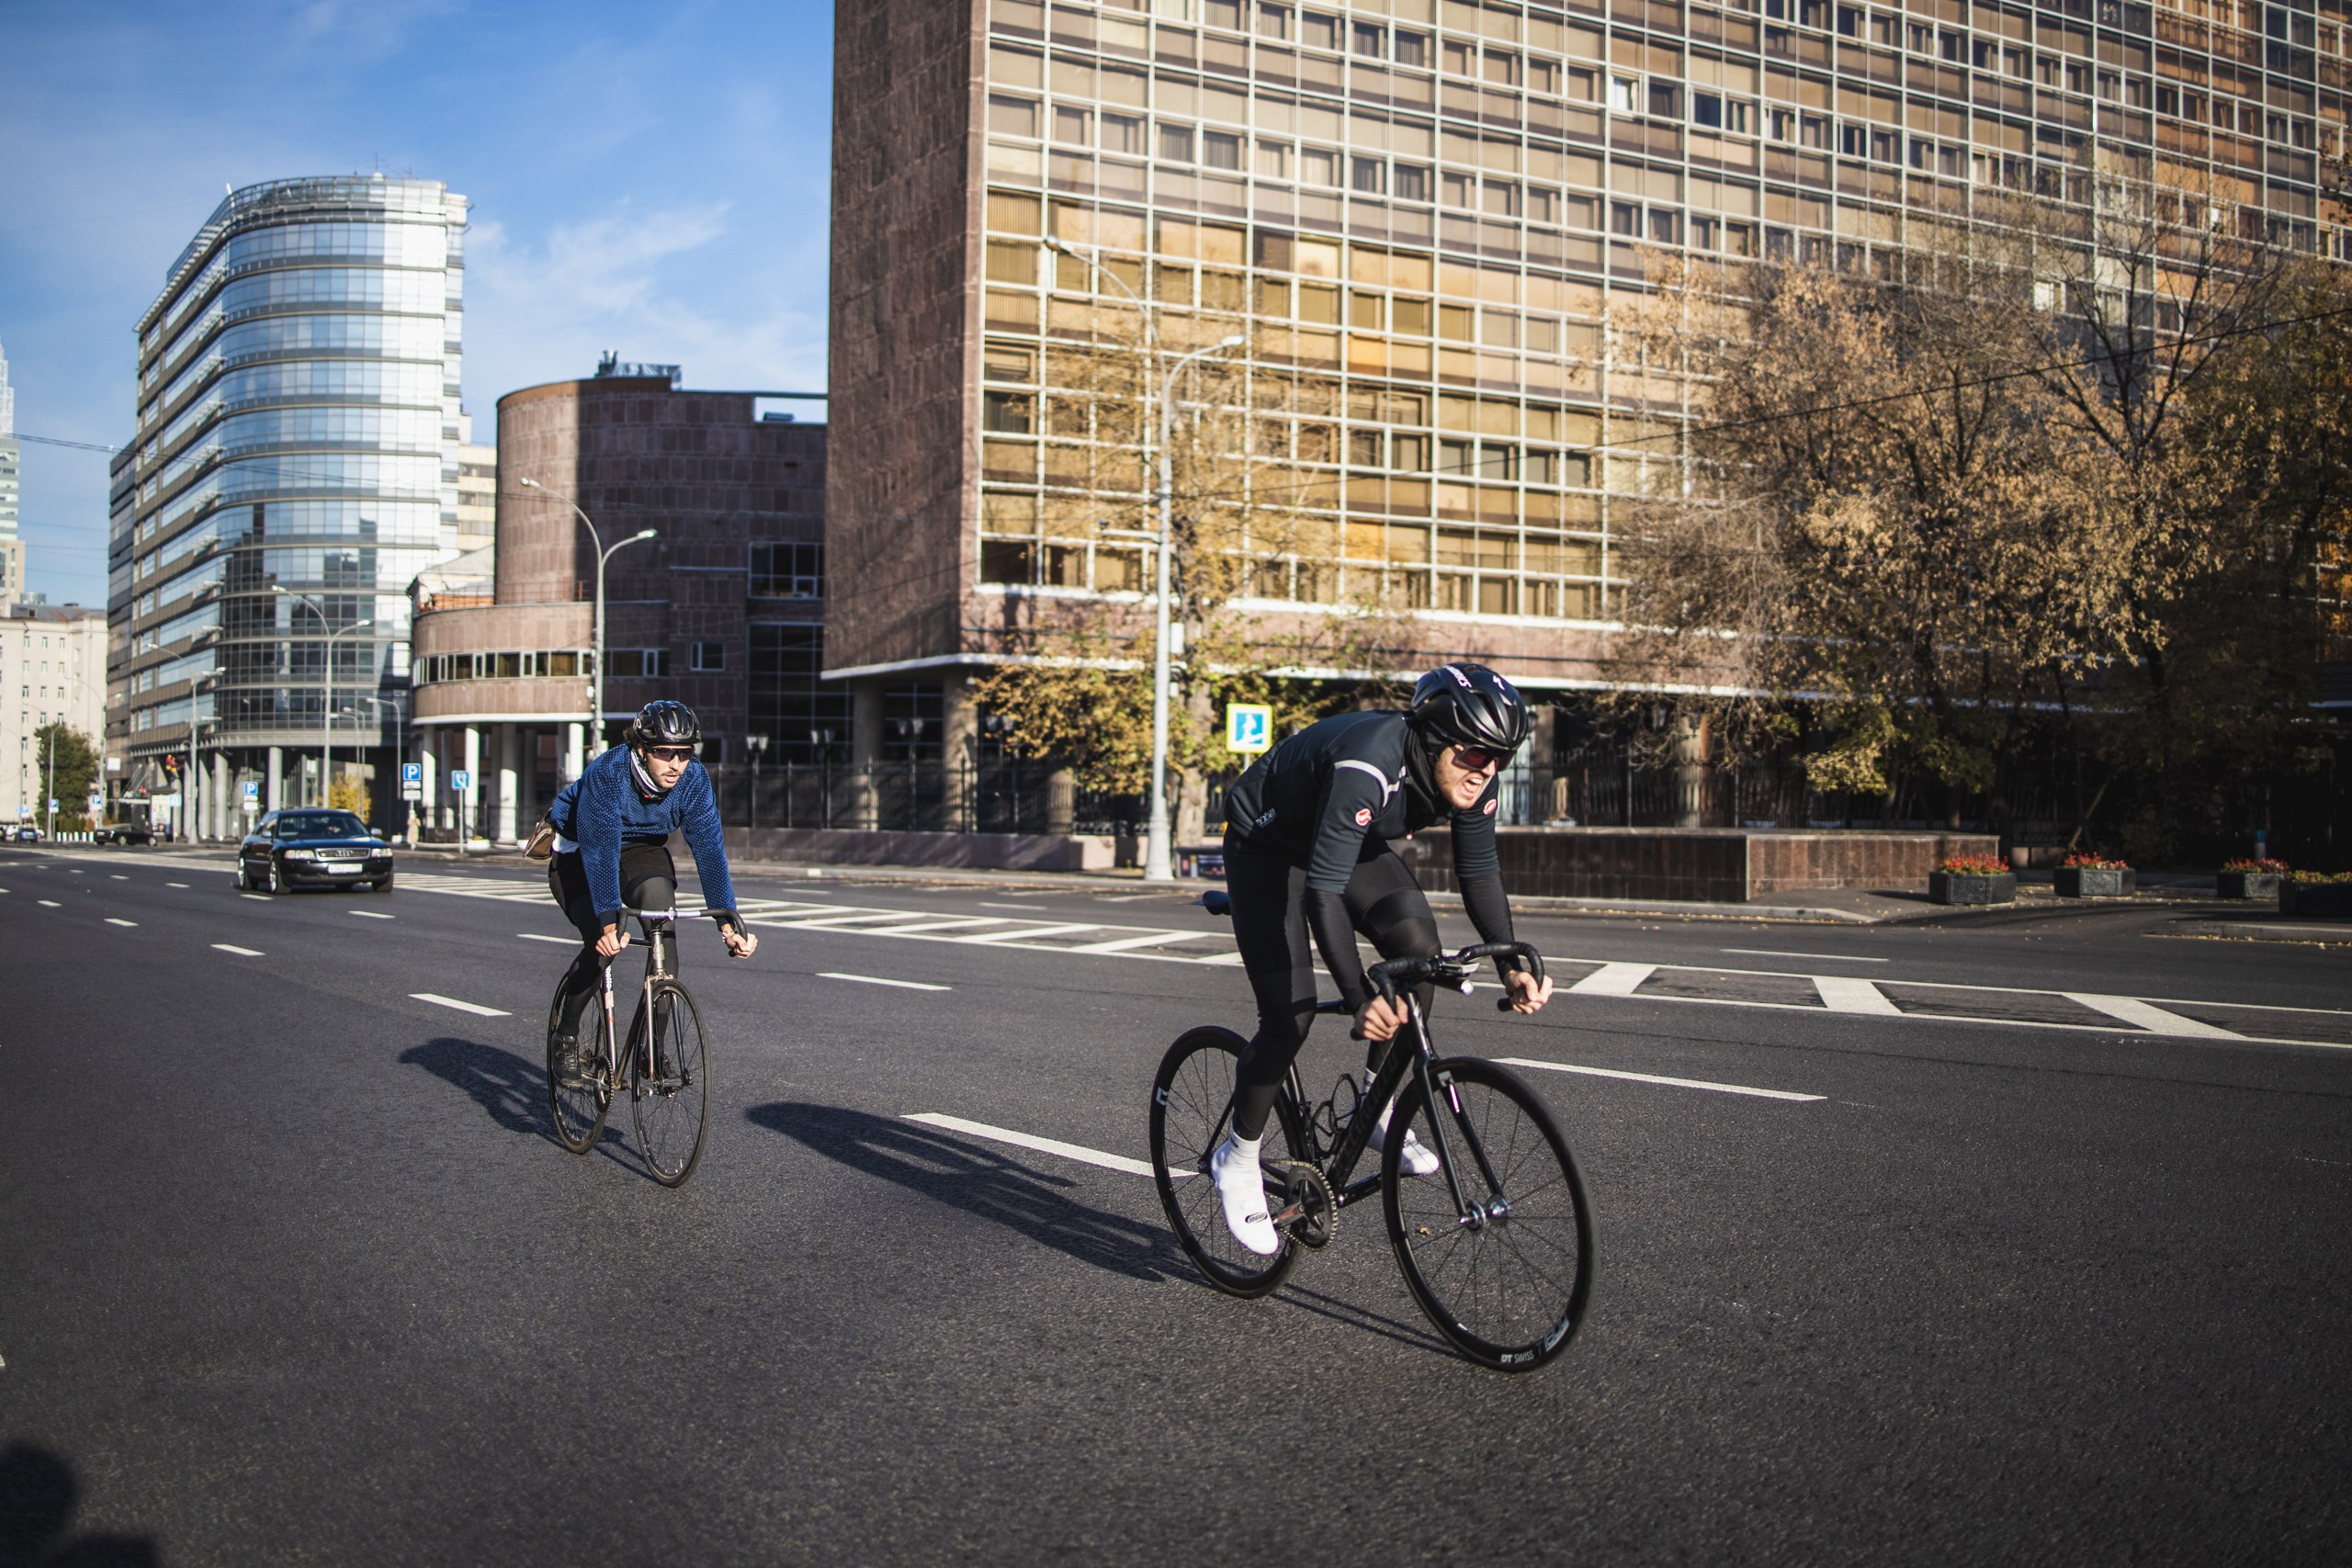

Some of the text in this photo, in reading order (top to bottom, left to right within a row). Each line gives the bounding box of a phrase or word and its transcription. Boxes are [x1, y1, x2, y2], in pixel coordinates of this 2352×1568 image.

[408, 765, 418, 779] P
[247, 783, 255, 794] P
[1501, 1349, 1534, 1363] DT SWISS
